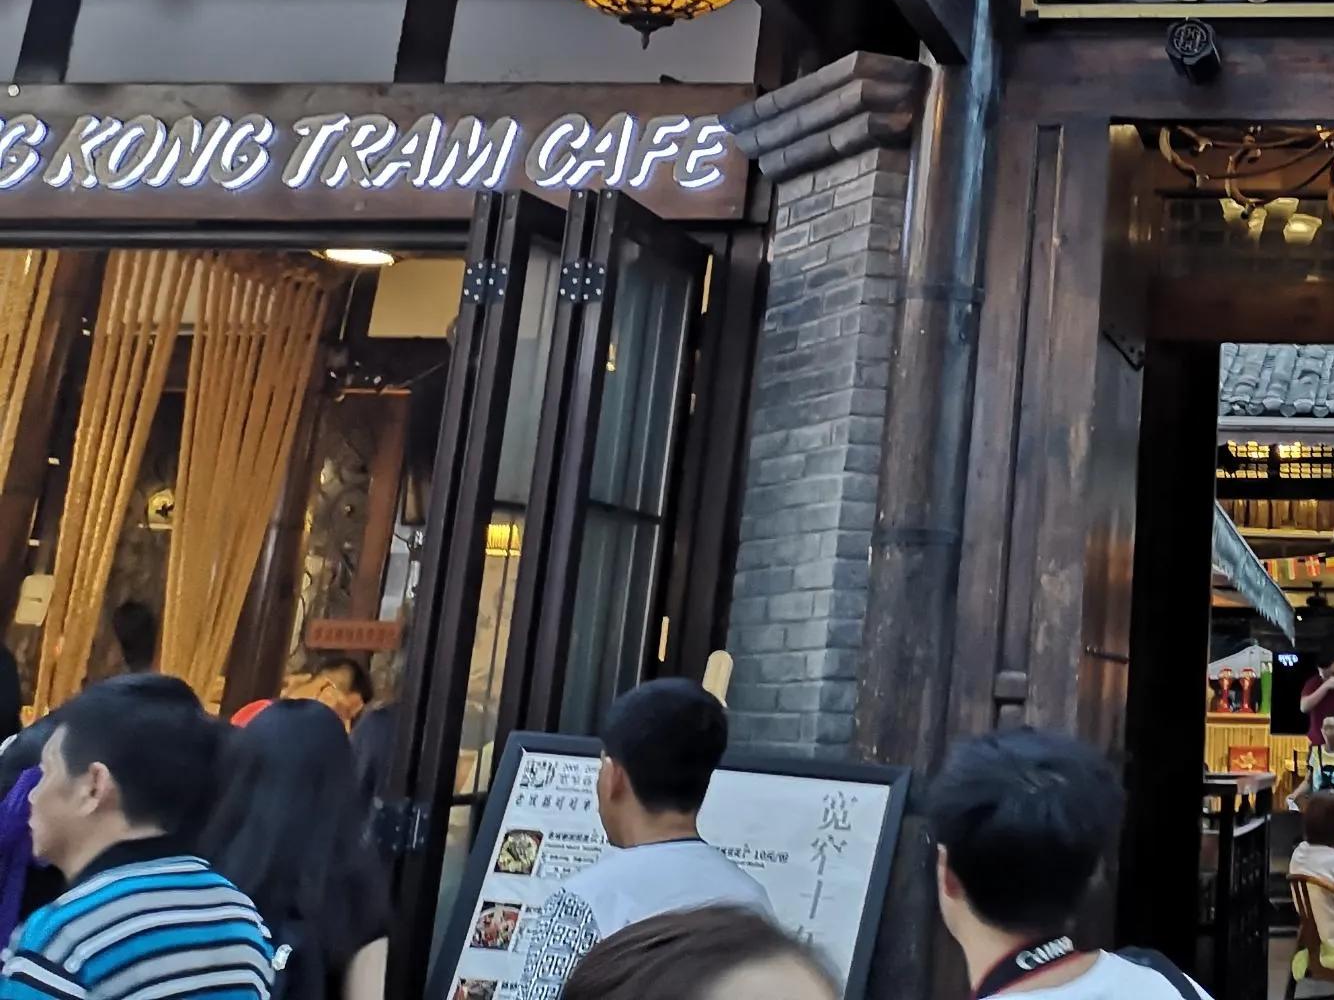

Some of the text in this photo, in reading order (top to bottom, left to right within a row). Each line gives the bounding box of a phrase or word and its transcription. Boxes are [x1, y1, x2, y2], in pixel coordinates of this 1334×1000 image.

[0, 111, 728, 190] G KONG TRAM CAFE
